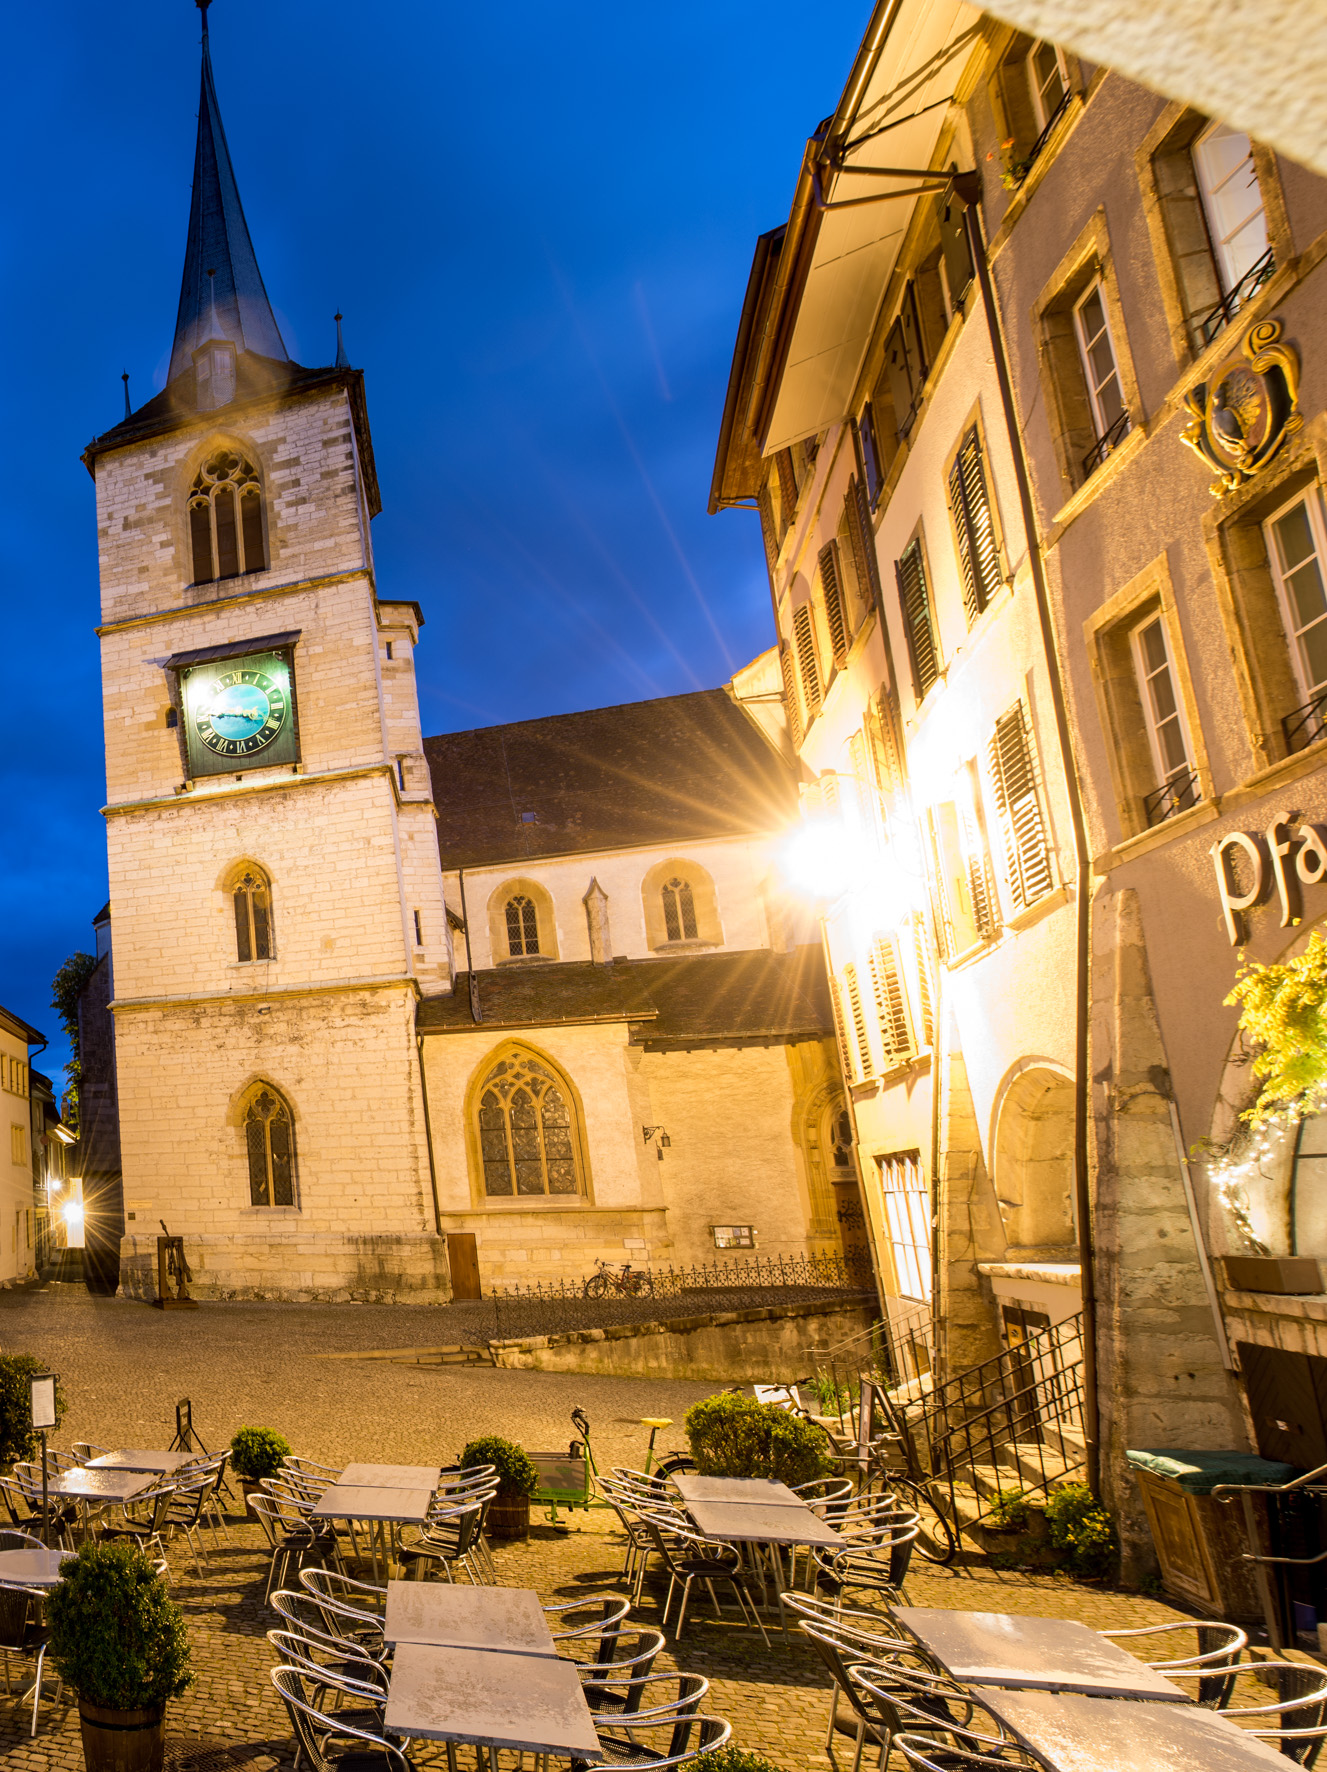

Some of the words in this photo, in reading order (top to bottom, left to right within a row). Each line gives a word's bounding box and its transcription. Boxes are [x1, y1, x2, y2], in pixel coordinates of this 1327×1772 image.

[232, 672, 243, 685] XII
[256, 734, 266, 746] V
[236, 741, 247, 753] VI
